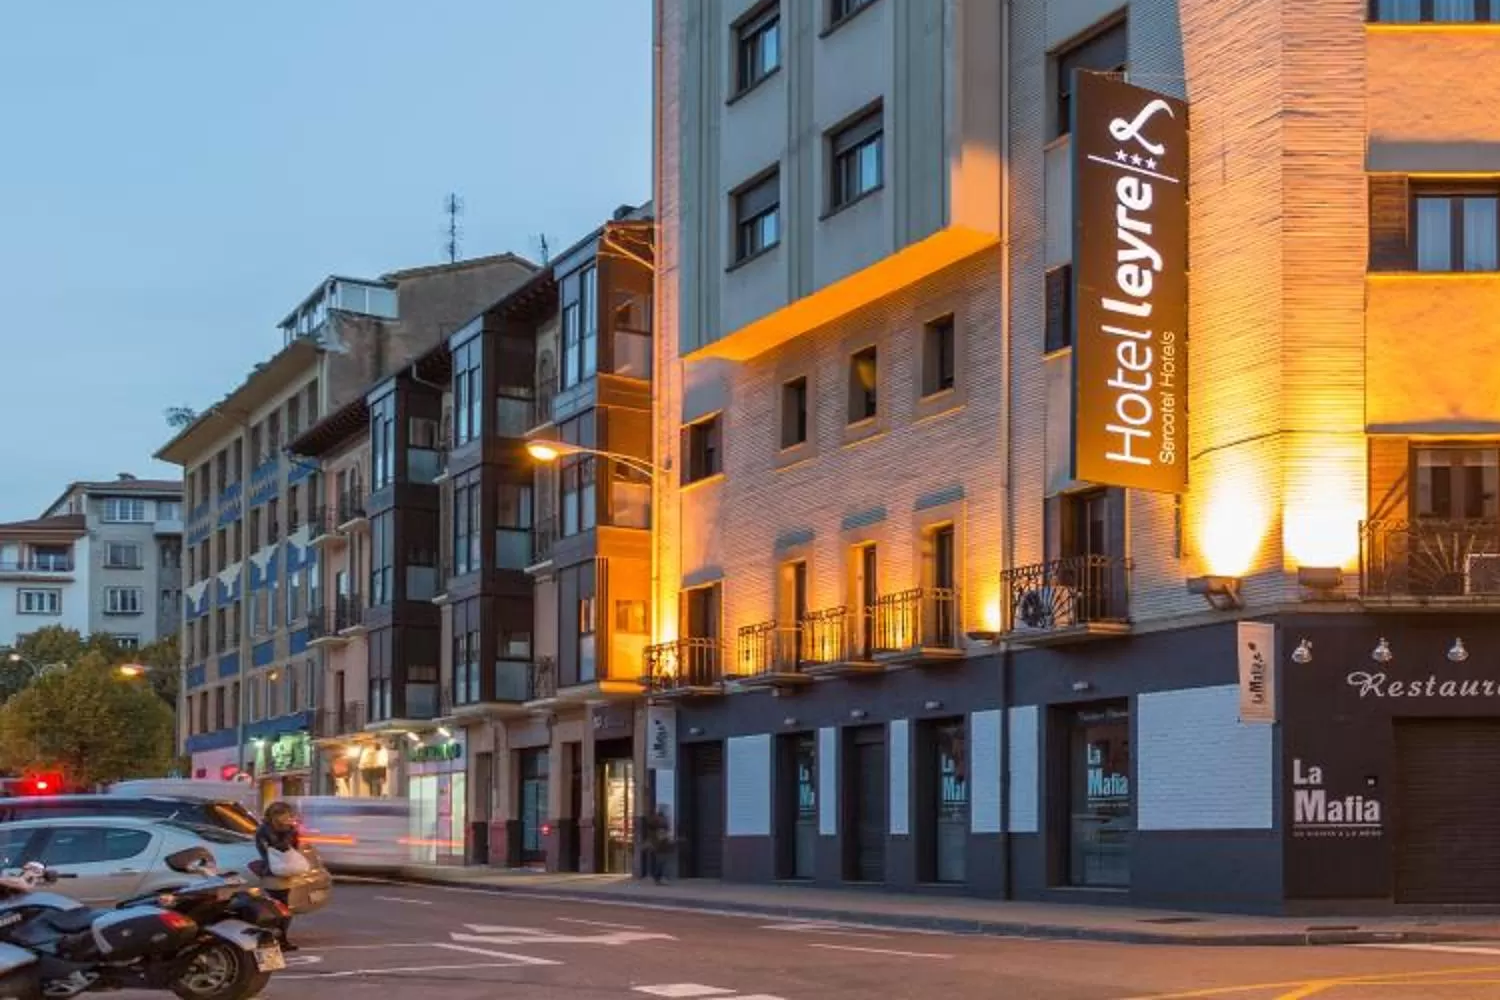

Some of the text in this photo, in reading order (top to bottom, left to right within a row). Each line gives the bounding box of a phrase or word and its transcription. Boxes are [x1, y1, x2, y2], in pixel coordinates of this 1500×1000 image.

[1101, 175, 1164, 467] Hotel leyre
[1160, 331, 1175, 464] Sercotel Hotels
[1086, 743, 1101, 765] La
[1087, 767, 1129, 796] Mafia
[1293, 759, 1322, 785] La
[1294, 790, 1380, 822] Mafia
